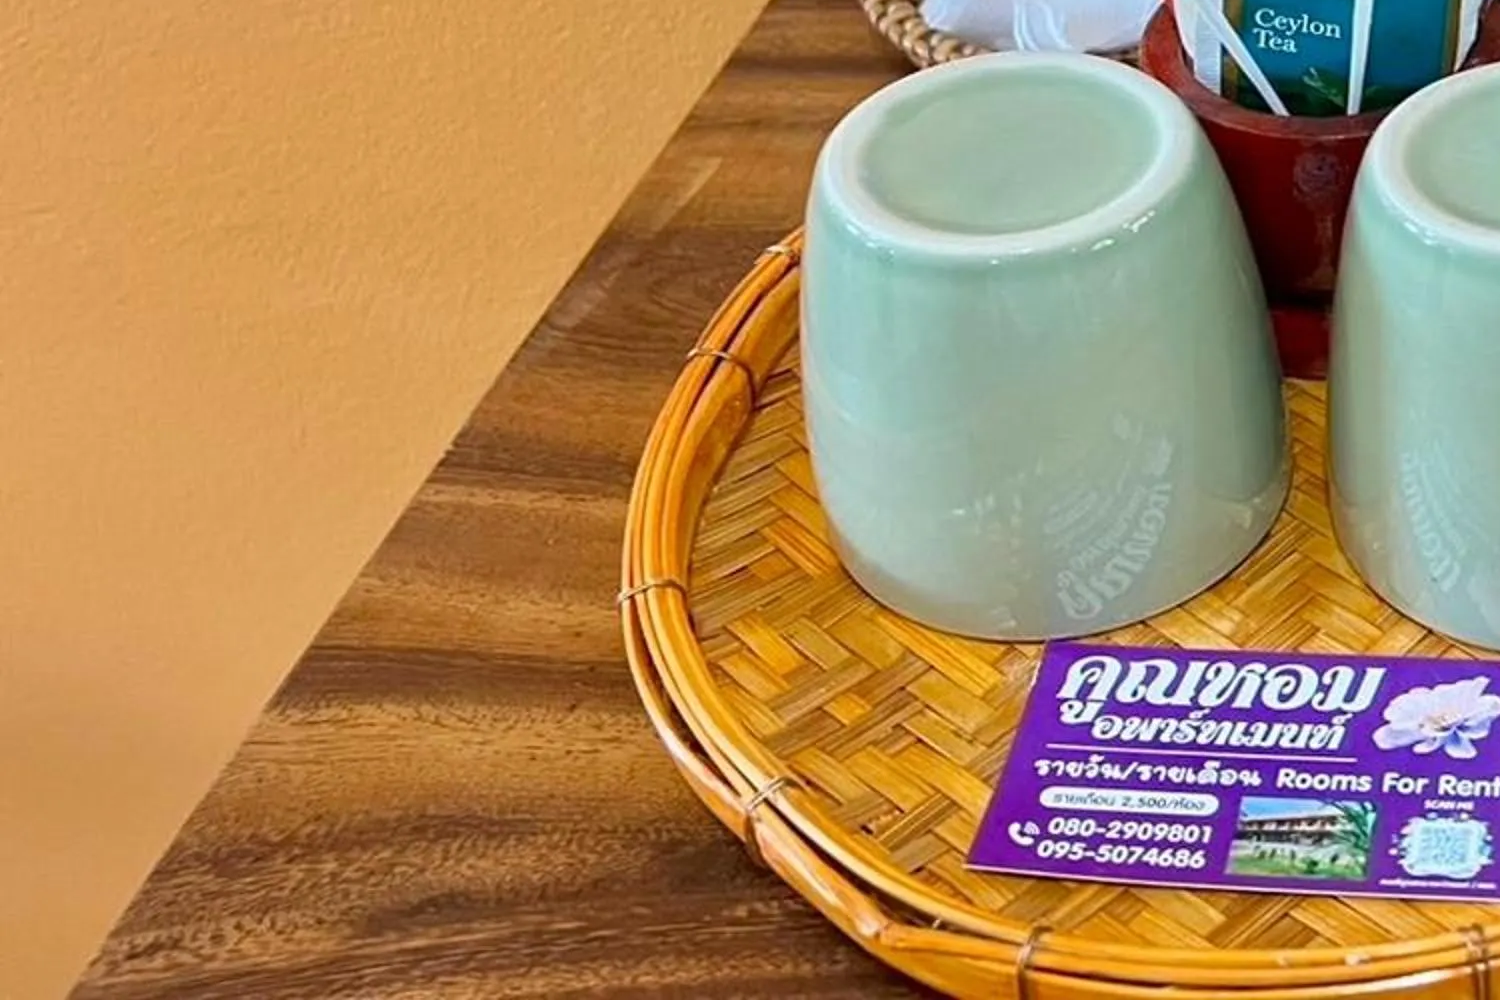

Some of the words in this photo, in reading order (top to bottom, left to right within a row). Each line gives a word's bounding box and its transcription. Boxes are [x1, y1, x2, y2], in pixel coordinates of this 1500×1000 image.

[1254, 7, 1341, 38] Ceylon
[1252, 28, 1297, 53] Tea
[1091, 707, 1353, 750] อพาร์ทเมนท์
[1276, 768, 1372, 792] Rooms
[1382, 772, 1429, 795] For
[1048, 817, 1213, 844] 080-2909801
[1036, 841, 1207, 869] 095-5074686
